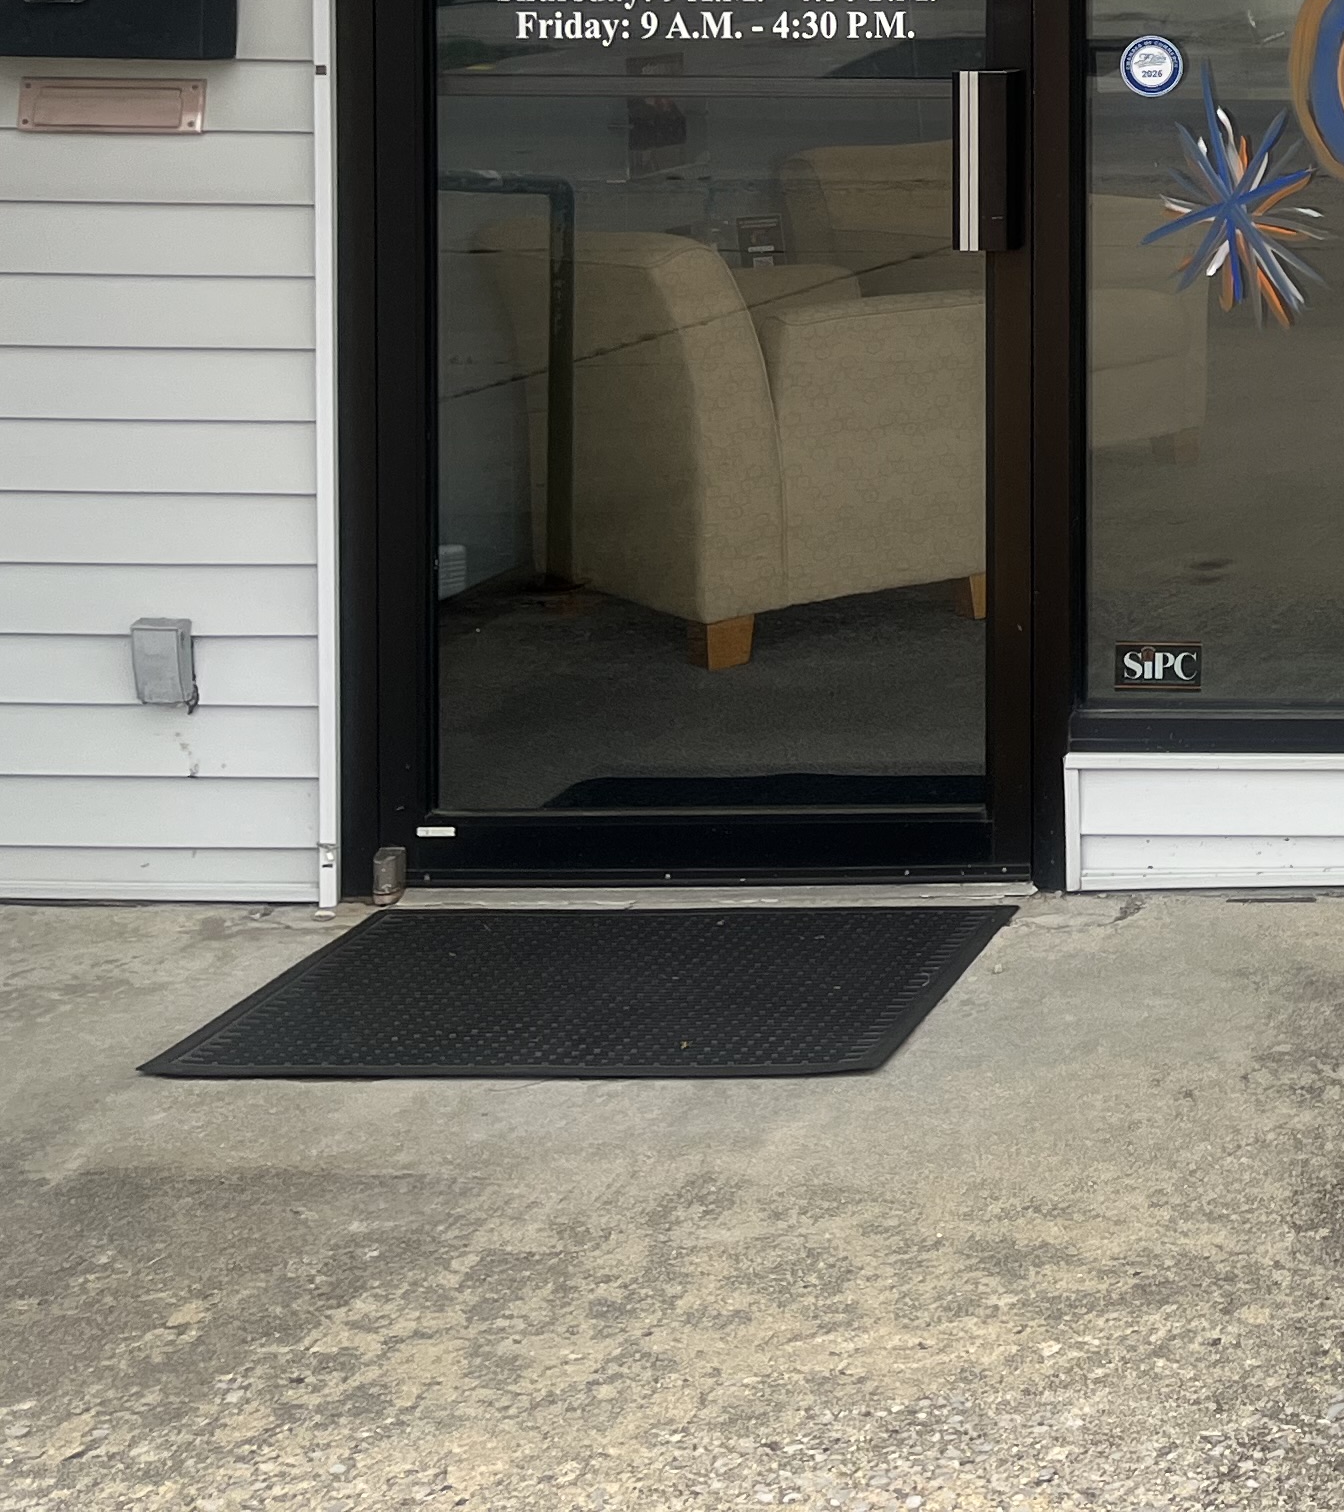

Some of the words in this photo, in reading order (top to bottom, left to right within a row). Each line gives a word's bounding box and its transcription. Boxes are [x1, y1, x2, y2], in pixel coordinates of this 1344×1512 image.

[516, 11, 630, 47] Friday:
[641, 11, 657, 40] 9
[666, 11, 743, 39] A.M.
[773, 11, 837, 39] 4:30
[847, 10, 915, 39] P.M.
[1141, 69, 1163, 78] 2026
